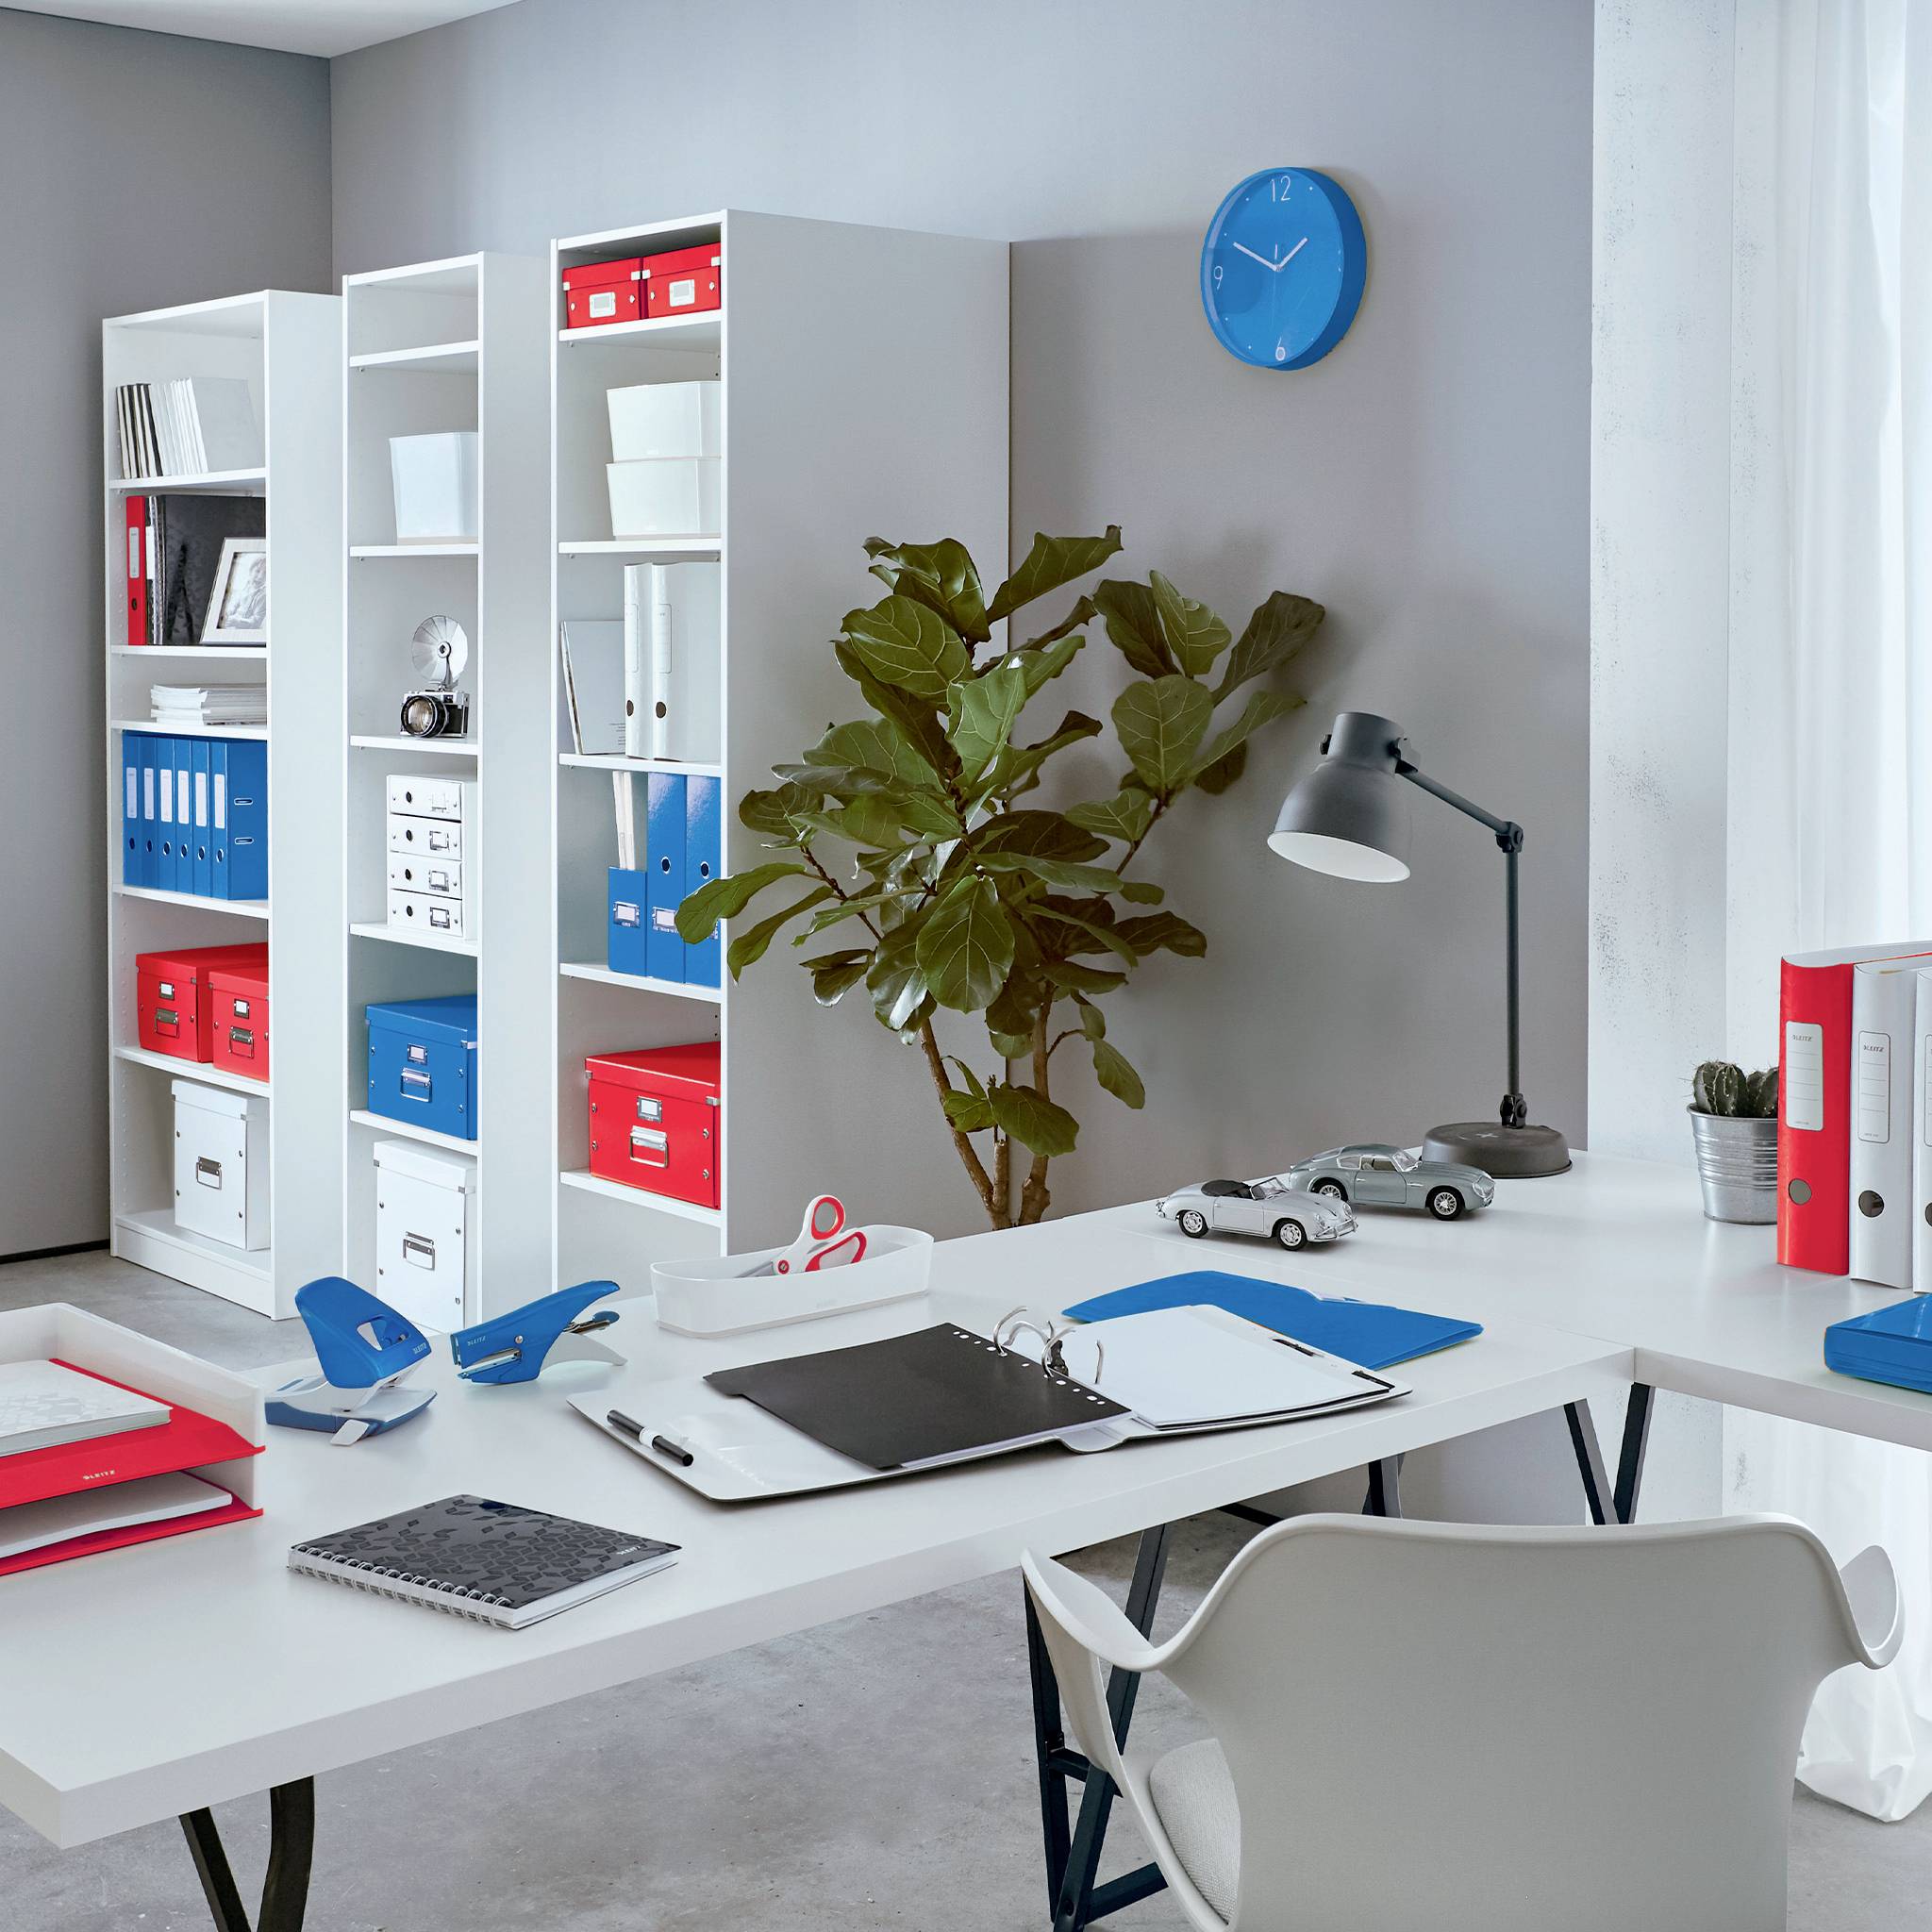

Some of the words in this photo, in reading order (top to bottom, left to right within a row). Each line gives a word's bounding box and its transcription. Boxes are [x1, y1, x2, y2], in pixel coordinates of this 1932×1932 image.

[1270, 175, 1291, 202] 12
[1213, 265, 1224, 291] 9
[1274, 336, 1286, 361] 6
[89, 1469, 115, 1480] LEITZ
